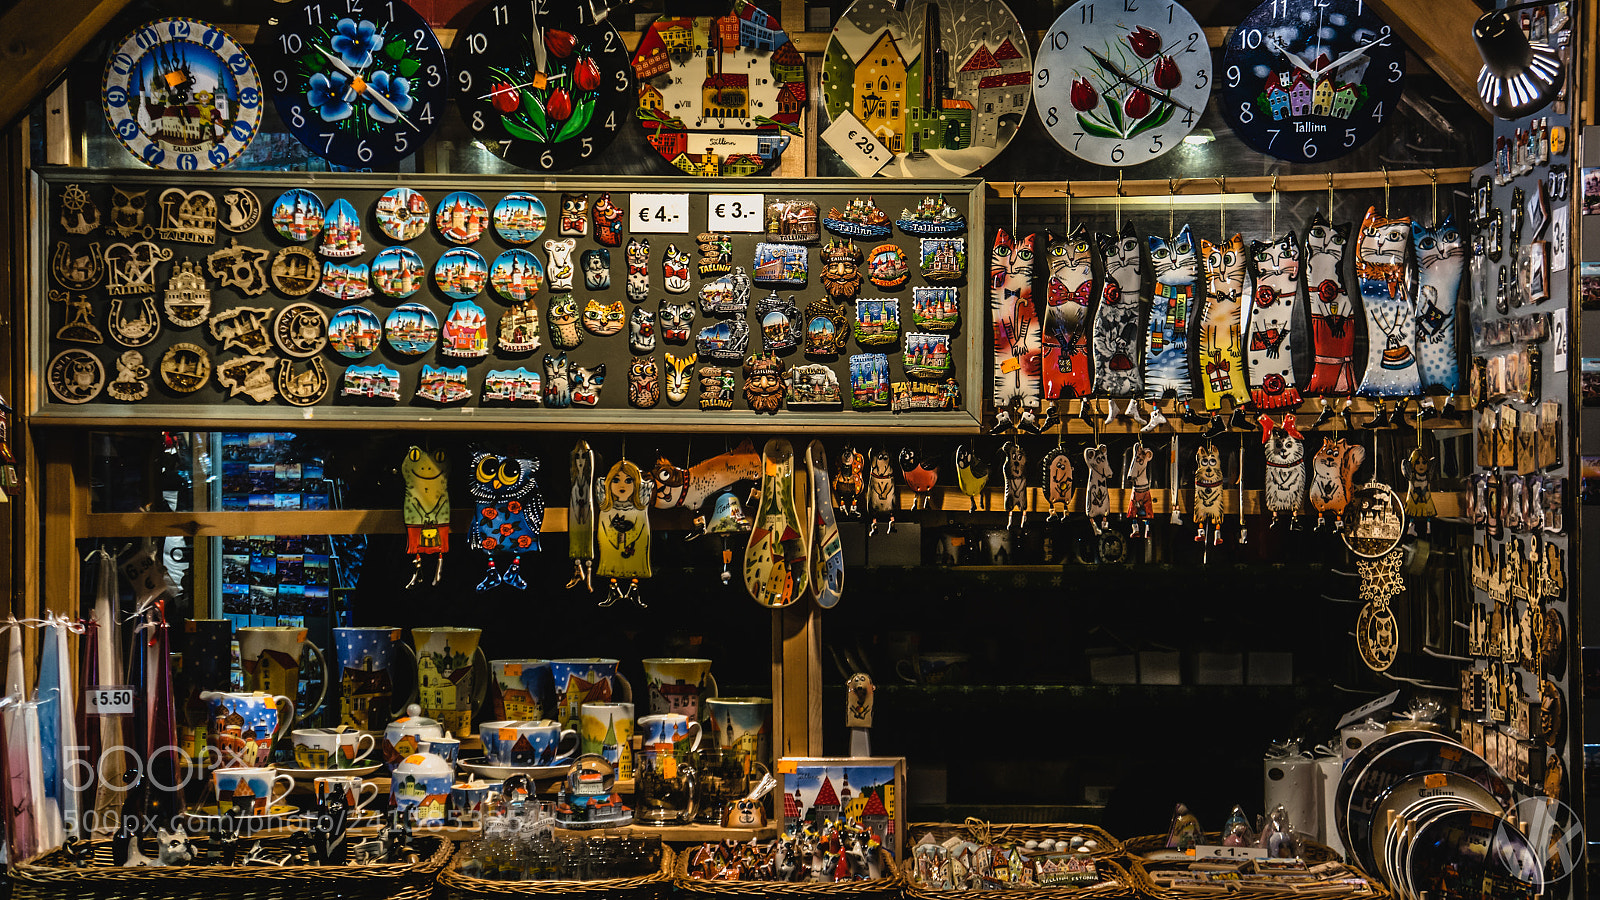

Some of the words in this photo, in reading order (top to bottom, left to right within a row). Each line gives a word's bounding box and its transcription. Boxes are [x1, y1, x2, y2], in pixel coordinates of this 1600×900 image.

[304, 4, 322, 25] 11
[346, 0, 363, 13] 12
[385, 1, 394, 22] 1
[493, 5, 508, 25] 11
[533, 0, 549, 15] 12
[577, 5, 583, 24] 1
[1079, 4, 1094, 24] 11
[1123, 0, 1139, 12] 12
[1166, 3, 1174, 24] 1
[1271, 0, 1287, 19] 11
[1357, 0, 1362, 17] 1
[138, 29, 157, 49] 11
[172, 21, 187, 37] 12
[1379, 26, 1391, 47] 2
[207, 33, 218, 48] 1
[279, 33, 302, 54] 10
[414, 29, 428, 51] 2
[465, 33, 487, 54] 10
[604, 31, 616, 53] 2
[1048, 31, 1068, 51] 10
[1186, 32, 1199, 52] 2
[1238, 29, 1262, 50] 10
[114, 55, 132, 72] 10
[230, 58, 246, 72] 2
[1388, 62, 1402, 83] 3
[273, 70, 288, 92] 9
[426, 65, 441, 87] 3
[458, 70, 472, 92] 9
[615, 70, 628, 91] 3
[1037, 69, 1049, 88] 9
[1195, 69, 1208, 90] 3
[1227, 65, 1240, 88] 9
[108, 94, 125, 103] 9
[241, 94, 258, 104] 3
[291, 106, 305, 128] 8
[420, 102, 434, 124] 4
[472, 111, 484, 132] 8
[605, 110, 616, 132] 4
[1046, 107, 1058, 127] 8
[1181, 106, 1194, 128] 4
[1240, 102, 1253, 124] 8
[1372, 101, 1384, 123] 4
[120, 122, 135, 135] 8
[235, 126, 250, 138] 4
[1293, 121, 1327, 133] Tallinn
[319, 133, 334, 153] 7
[394, 131, 408, 152] 5
[581, 137, 593, 157] 5
[847, 130, 857, 140] €
[855, 136, 880, 162] 29.-
[1072, 133, 1084, 151] 7
[1149, 135, 1163, 153] 5
[1266, 129, 1280, 149] 7
[1343, 128, 1356, 147] 5
[148, 146, 161, 163] 7
[213, 146, 225, 163] 5
[358, 140, 372, 162] 6
[499, 140, 512, 157] 7
[1111, 144, 1124, 163] 6
[1303, 138, 1317, 158] 6
[182, 155, 192, 170] 6
[540, 150, 553, 169] 6
[638, 208, 650, 222] €
[655, 206, 679, 222] 4.-
[715, 204, 726, 218] €
[731, 202, 755, 218] 3.-
[160, 232, 214, 243] TALLINN
[838, 224, 872, 235] Tallinn
[912, 224, 946, 232] Tallinn
[699, 263, 732, 273] TALLINN
[108, 285, 156, 296] TALLINN
[279, 309, 297, 350] ESTONIA
[700, 399, 733, 408] TALLINN
[1419, 788, 1455, 798] Tallinn
[1227, 848, 1249, 858] 1.-
